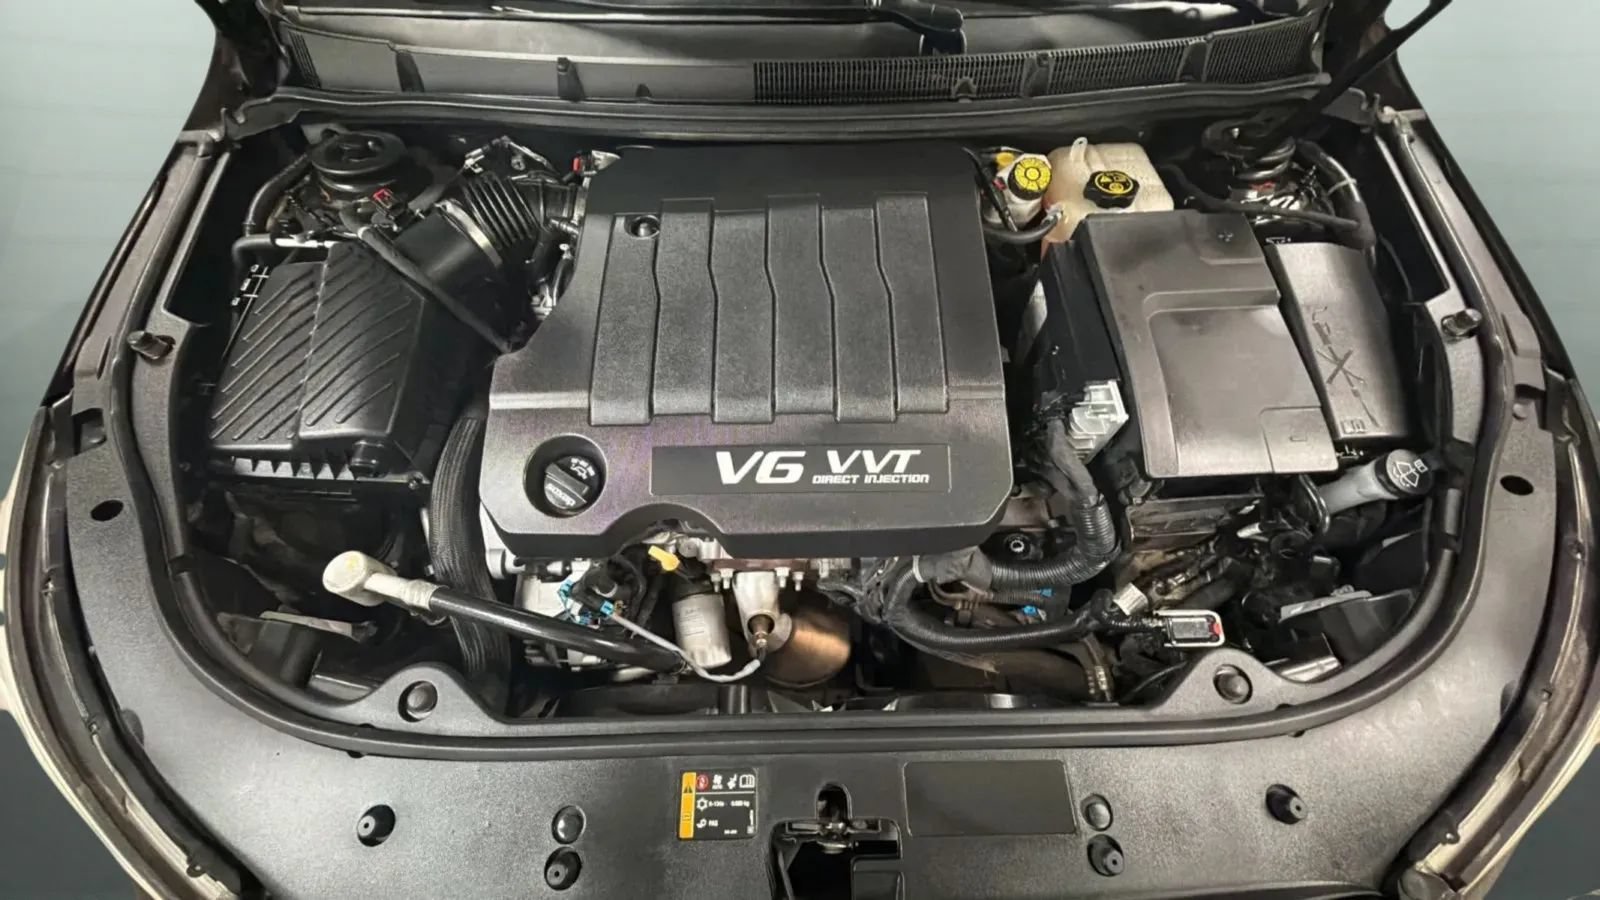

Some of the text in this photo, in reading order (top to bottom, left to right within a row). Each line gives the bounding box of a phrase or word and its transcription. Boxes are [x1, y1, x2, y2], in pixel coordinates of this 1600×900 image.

[716, 451, 806, 484] V6
[826, 450, 921, 474] VVT
[812, 474, 930, 485] DIRECT INJECTION
